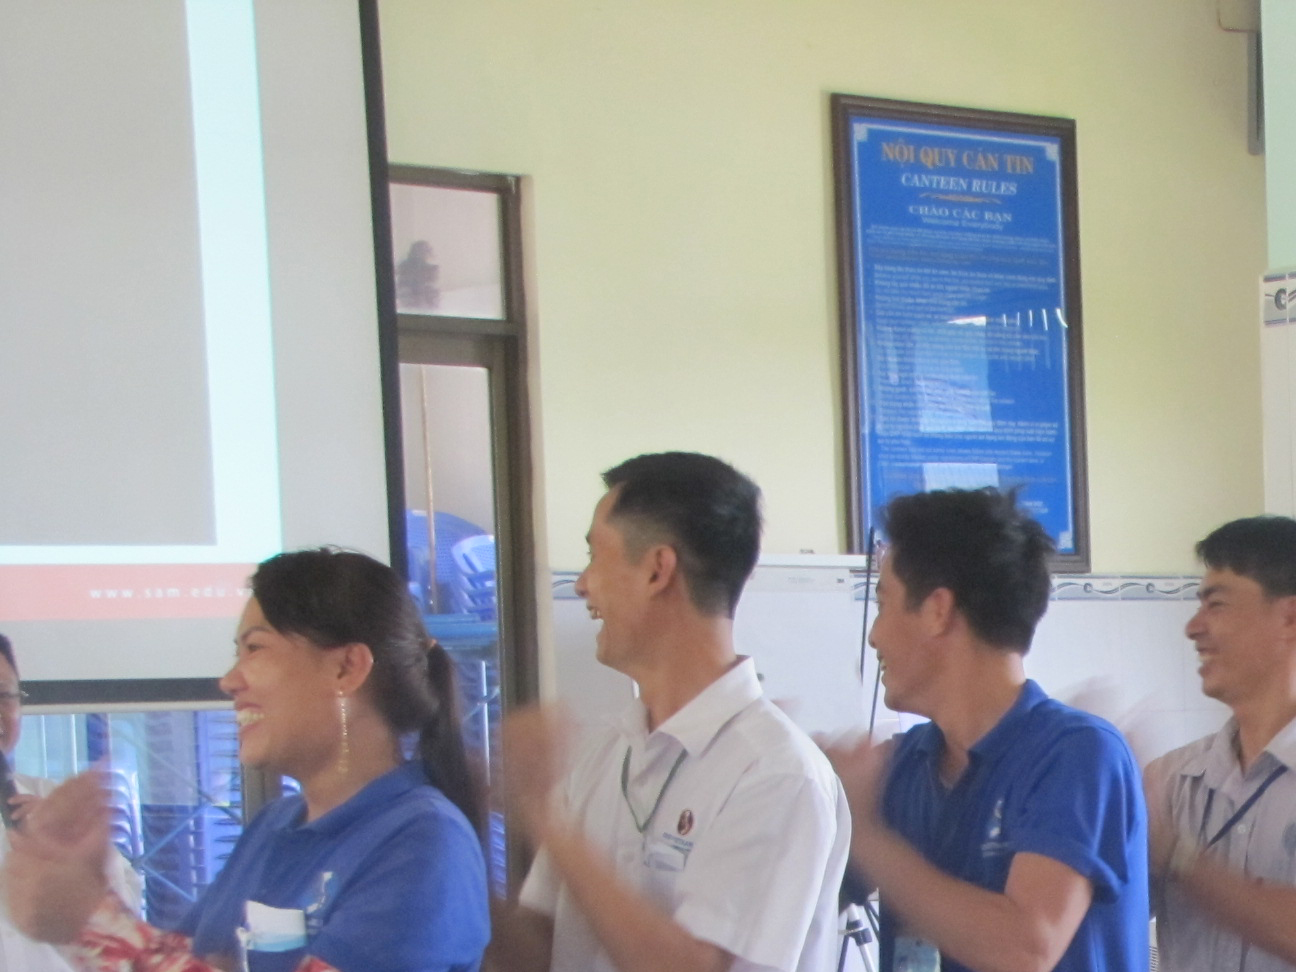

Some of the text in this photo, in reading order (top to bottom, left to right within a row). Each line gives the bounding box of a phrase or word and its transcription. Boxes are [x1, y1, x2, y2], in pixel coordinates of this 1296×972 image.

[920, 146, 957, 168] QUY
[1005, 154, 1034, 174] TIN
[901, 173, 1018, 196] CANTEEN RULES
